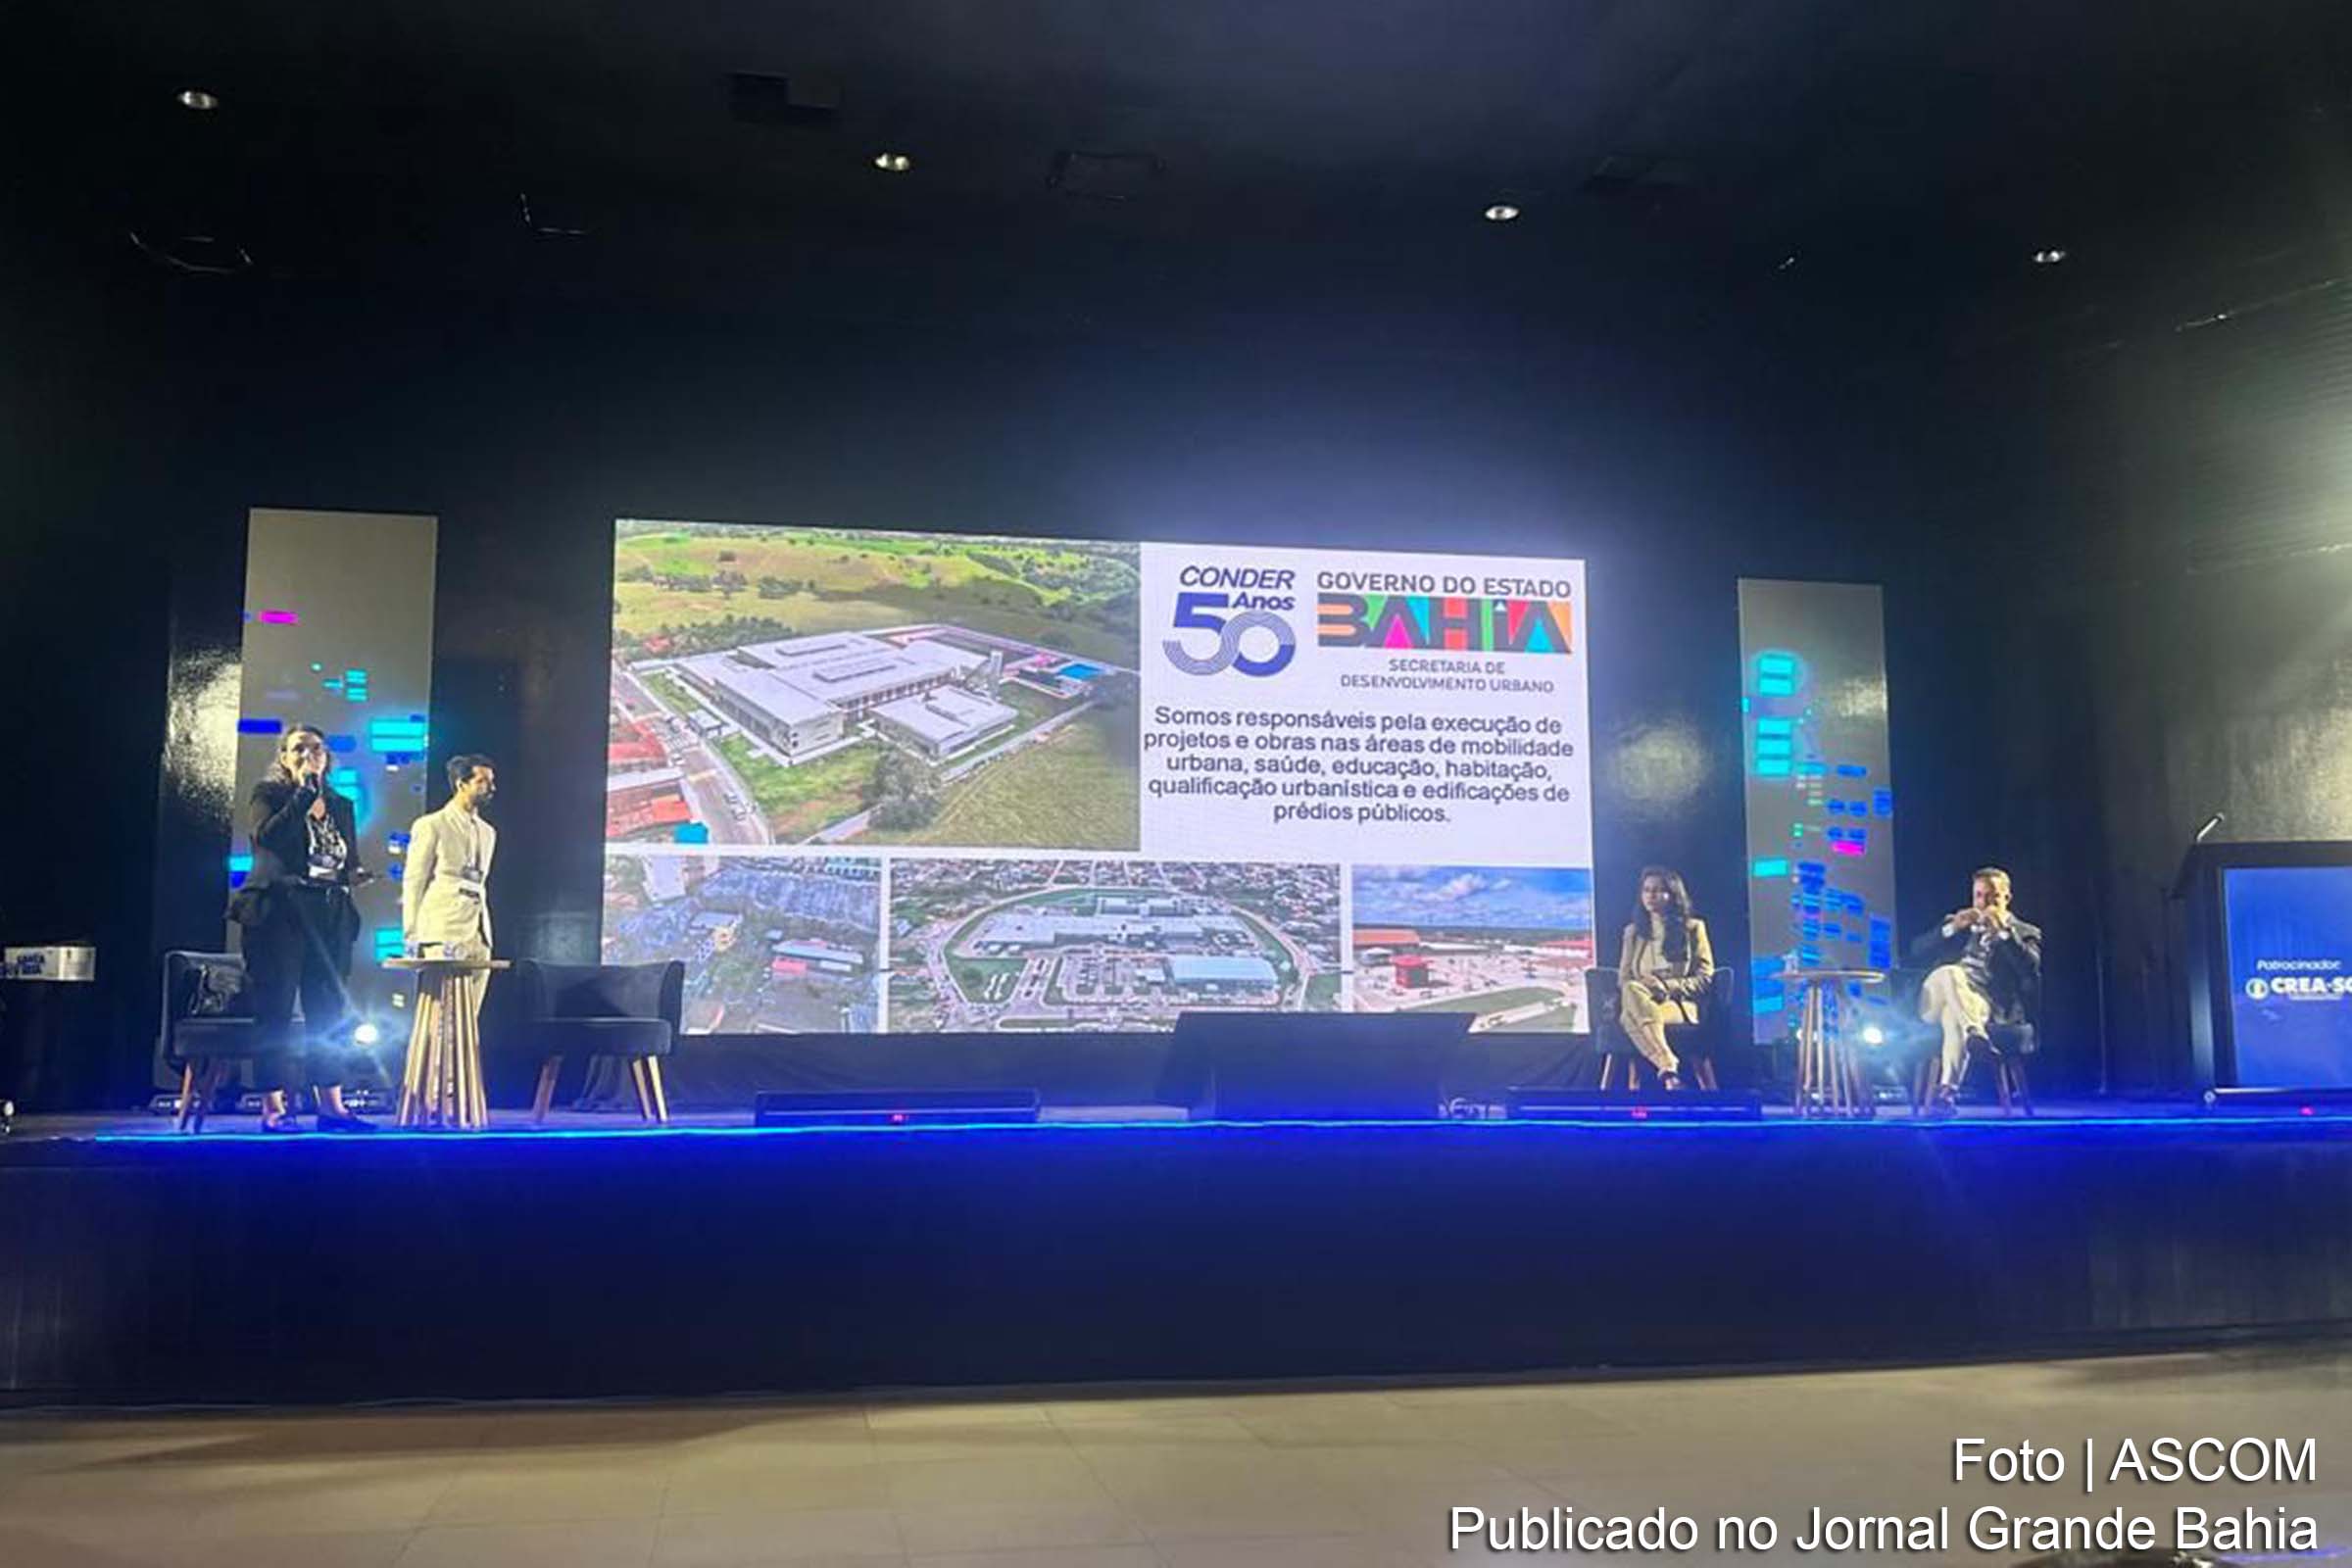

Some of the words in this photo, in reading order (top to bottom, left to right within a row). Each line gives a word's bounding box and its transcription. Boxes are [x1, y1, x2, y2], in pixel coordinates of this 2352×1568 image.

[1179, 564, 1295, 589] CONDER
[1317, 571, 1435, 593] GOVERNO
[1443, 575, 1476, 594] DO
[1484, 578, 1571, 598] ESTADO
[1233, 591, 1295, 611] Anos
[1162, 591, 1296, 676] 50
[1388, 659, 1477, 674] SECRETARIA
[1481, 662, 1505, 675] DE
[1340, 674, 1487, 691] DESENVOLVIMENTO
[1489, 678, 1554, 694] URBANO
[1154, 707, 1232, 726] Somos
[1236, 710, 1376, 732] responsáveis
[1381, 713, 1427, 734] pela
[1431, 715, 1531, 736] execução
[1536, 716, 1562, 734] de
[1144, 733, 1231, 752] projetos
[1235, 736, 1250, 750] e
[1255, 732, 1317, 752] obras
[1321, 736, 1360, 752] nas
[1365, 736, 1425, 754] áreas
[1430, 736, 1455, 755] de
[1461, 738, 1574, 758] mobilidade
[1167, 756, 1250, 775] urbana,
[1253, 757, 1326, 776] saúde,
[1332, 759, 1441, 780] educação,
[1446, 761, 1552, 781] habitação,
[1148, 778, 1278, 799] qualificação
[1282, 779, 1399, 799] urbanística
[1403, 784, 1417, 799] e
[1423, 780, 1541, 804] edificações
[1544, 784, 1570, 802] de
[1273, 803, 1353, 823] prédios
[1358, 803, 1450, 824] públicos.
